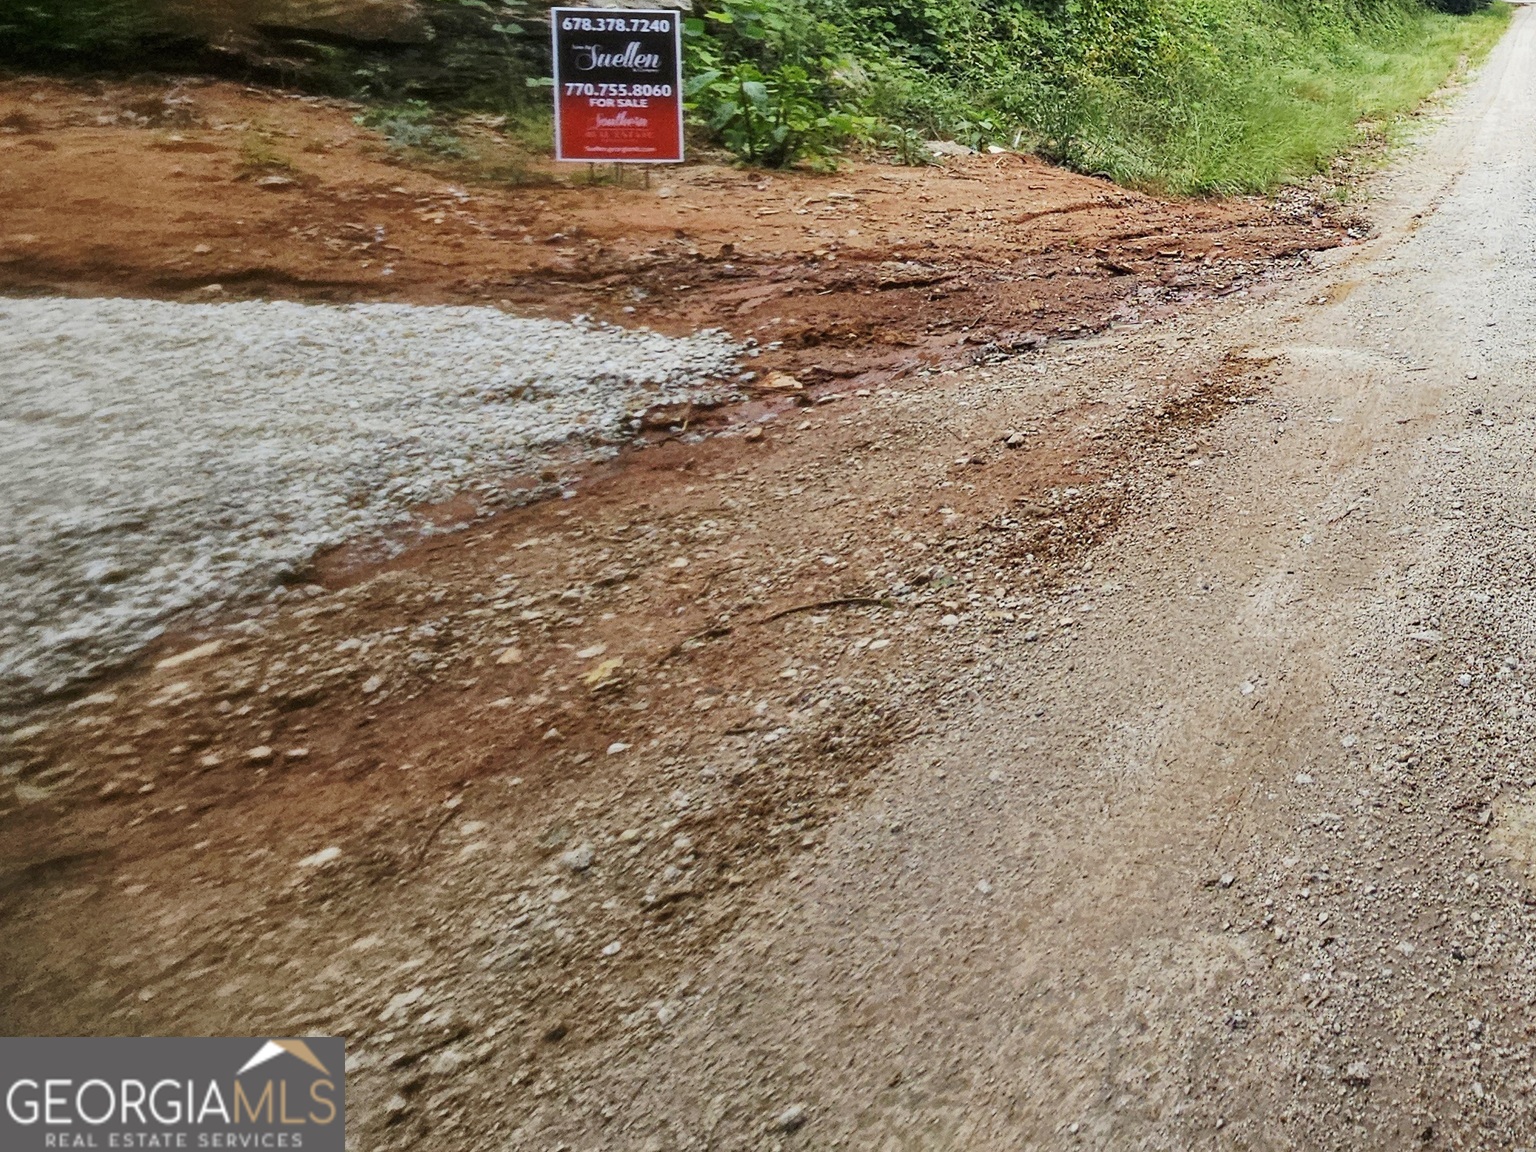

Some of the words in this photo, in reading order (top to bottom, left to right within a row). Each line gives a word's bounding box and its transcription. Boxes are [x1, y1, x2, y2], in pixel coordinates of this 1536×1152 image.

[562, 18, 670, 32] 678.378.7240
[577, 42, 661, 70] Suellen
[565, 83, 672, 97] 770.755.8060
[589, 99, 616, 107] FOR
[617, 99, 648, 108] SALE
